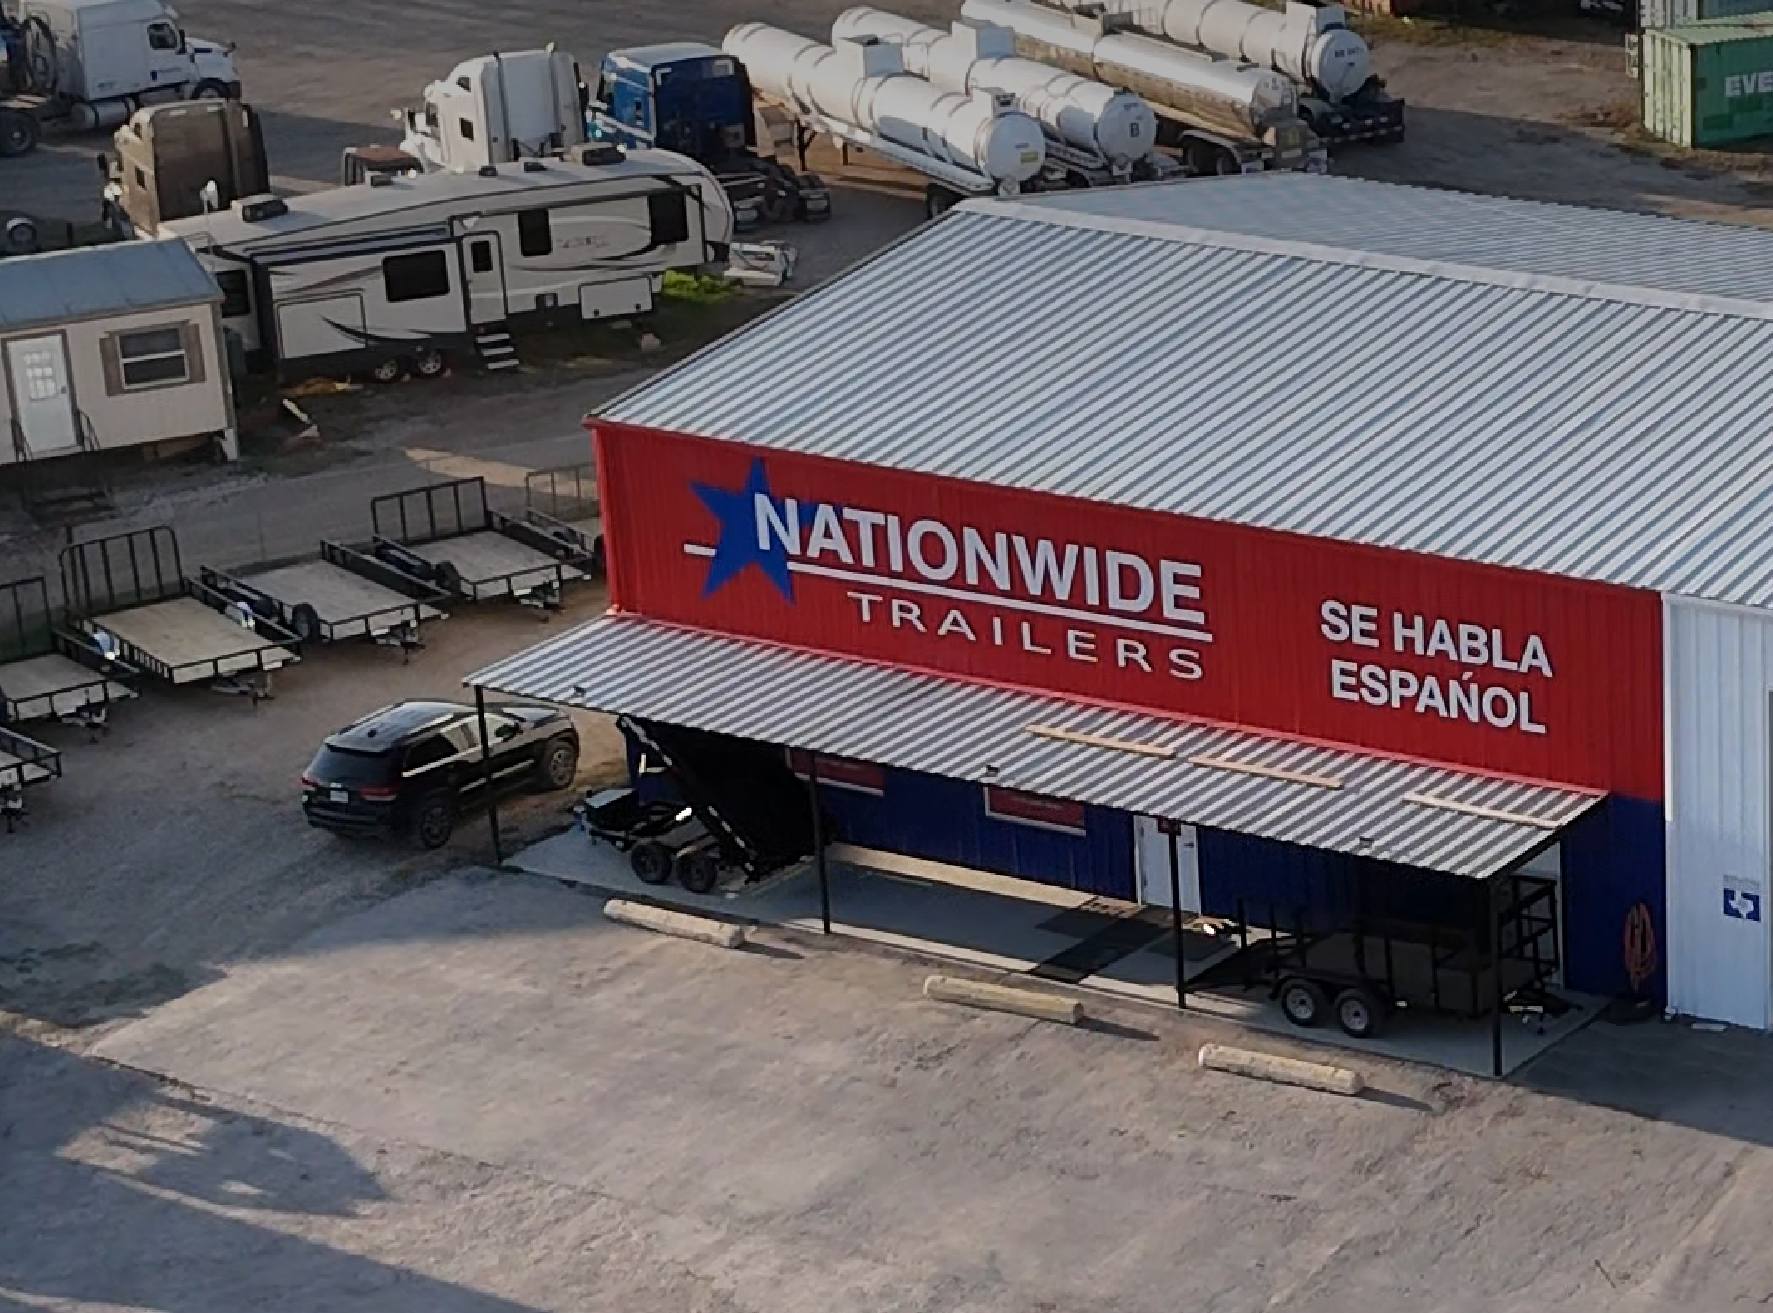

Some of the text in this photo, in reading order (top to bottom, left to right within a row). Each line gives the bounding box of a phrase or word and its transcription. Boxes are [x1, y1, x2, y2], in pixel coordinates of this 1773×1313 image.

[754, 493, 1206, 625] NATIONWIDE
[847, 591, 1203, 679] TRAILERS
[1321, 599, 1553, 678] SE HABLA
